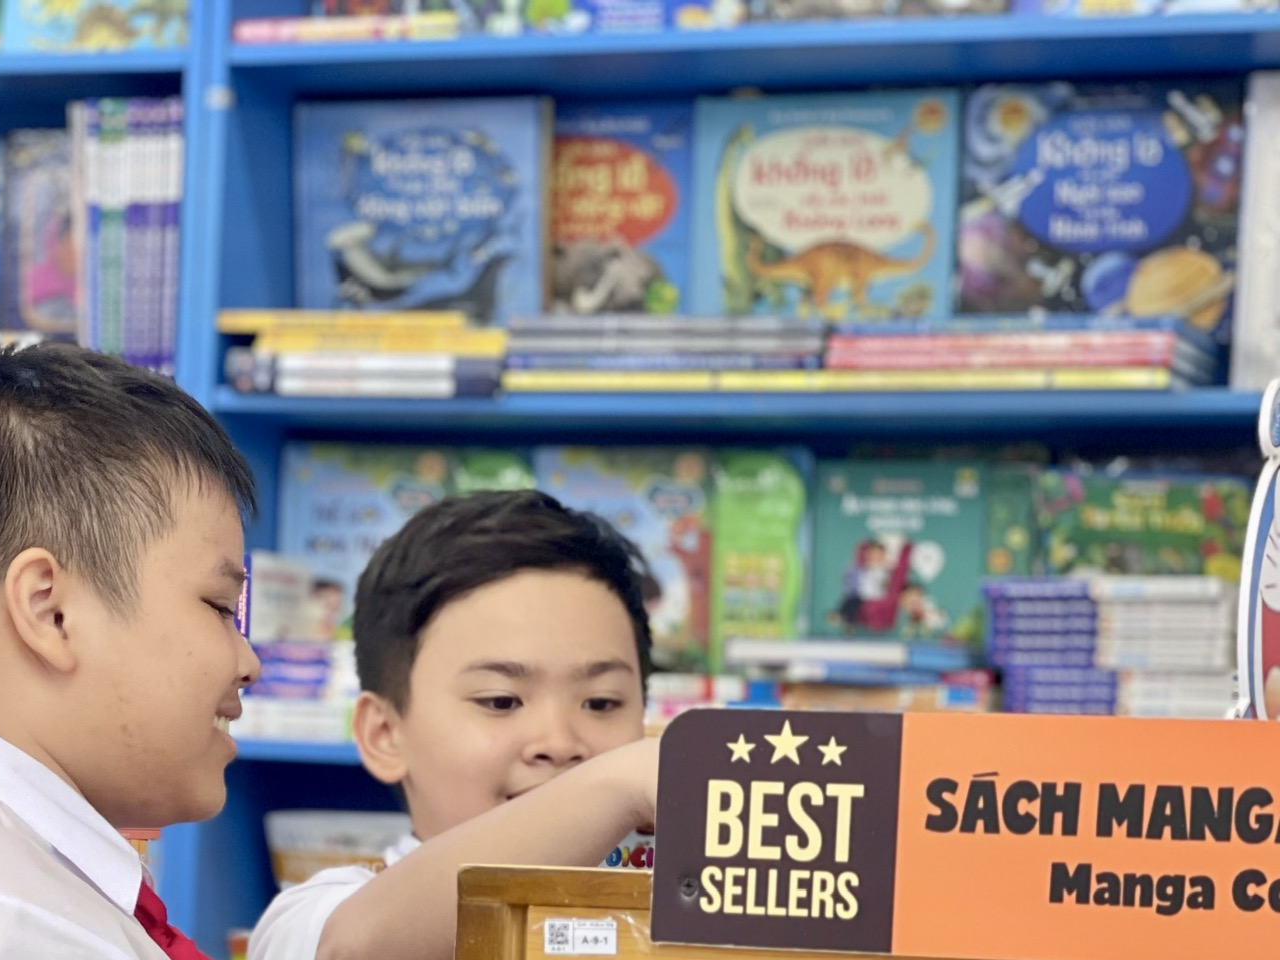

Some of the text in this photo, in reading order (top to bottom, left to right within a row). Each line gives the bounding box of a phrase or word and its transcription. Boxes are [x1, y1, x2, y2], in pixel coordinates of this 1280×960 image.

[703, 779, 864, 864] BEST
[924, 772, 1280, 845] SÁCH MANG
[699, 865, 860, 921] SELLERS
[1049, 862, 1216, 916] Manga
